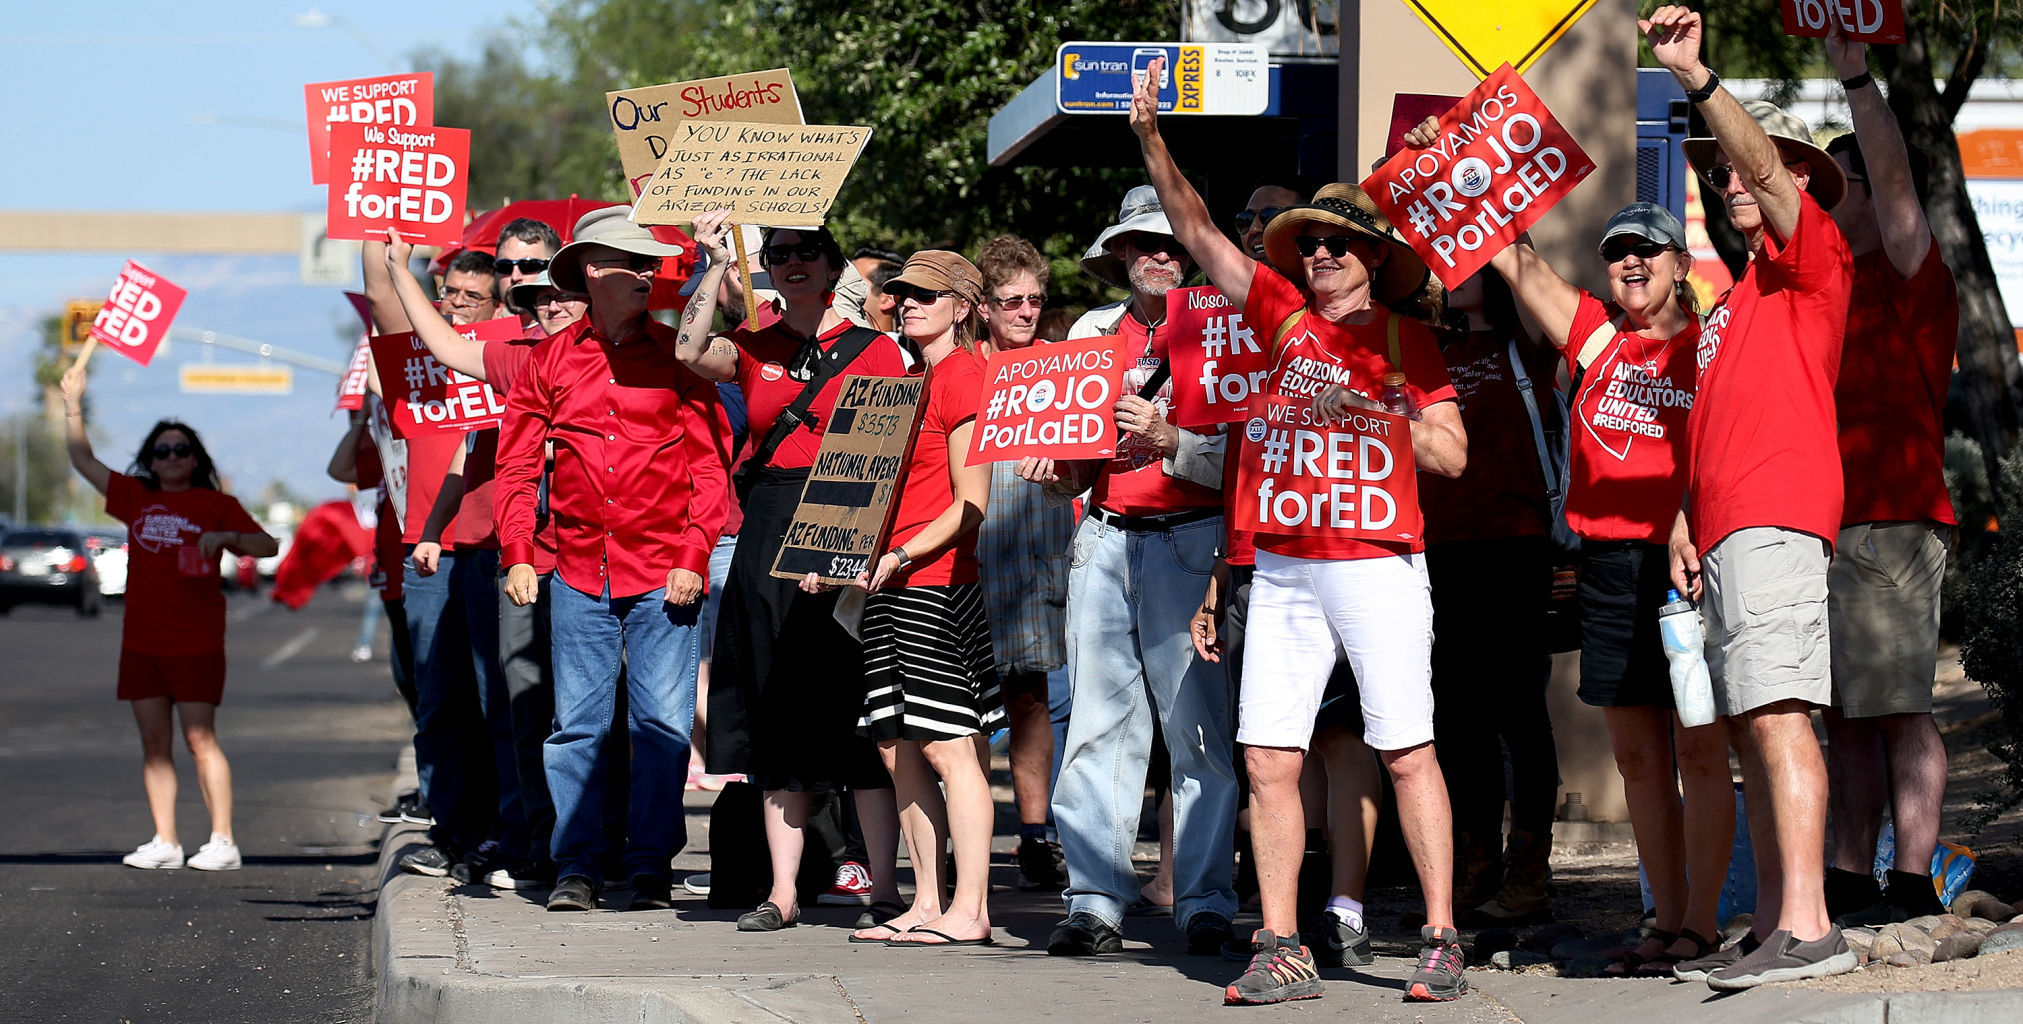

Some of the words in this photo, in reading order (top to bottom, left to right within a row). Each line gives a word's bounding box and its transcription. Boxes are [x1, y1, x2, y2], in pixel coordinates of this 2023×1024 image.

[321, 87, 350, 103] WE
[353, 80, 418, 100] SUPPORT
[1183, 49, 1200, 109] EXPRESS
[612, 96, 668, 131] Our
[680, 80, 783, 117] Students
[364, 126, 385, 143] We
[388, 129, 436, 151] Support
[683, 125, 730, 144] YOU
[738, 128, 795, 144] KNOW
[800, 130, 860, 145] WHAT'S
[1388, 84, 1518, 204] APOYAMOS
[350, 148, 456, 187] #RED
[669, 150, 714, 163] JUST
[659, 167, 685, 180] AS
[741, 168, 775, 181] THE
[780, 168, 822, 180] LACK
[1406, 112, 1542, 239] #ROJO
[344, 182, 453, 224] forED
[651, 185, 678, 196] OF
[684, 185, 755, 197] FUNDING
[763, 186, 780, 196] IN
[787, 186, 821, 197] OUR
[657, 200, 735, 213] ARIZONA
[746, 198, 829, 214] SCHOOLS!
[1431, 146, 1567, 268] PorLaED
[994, 349, 1114, 385] APOYAMOS
[1287, 355, 1351, 386] ARIZONA
[1611, 361, 1673, 387] ARIZONA
[840, 376, 872, 407] AZ
[986, 374, 1110, 421] #ROJO
[1605, 380, 1694, 410] EDUCATORS
[1268, 403, 1297, 423] WE
[1300, 407, 1391, 437] SPORT
[1597, 396, 1659, 422] UNITED
[978, 413, 1105, 452] PorLaED
[1592, 412, 1664, 438] #REDFORED
[814, 450, 867, 480] NATIONAL
[1261, 429, 1394, 482] #RED
[1257, 478, 1397, 531] forED
[784, 520, 809, 545] AZ
[802, 523, 859, 551] FUNDING
[859, 533, 875, 550] PER
